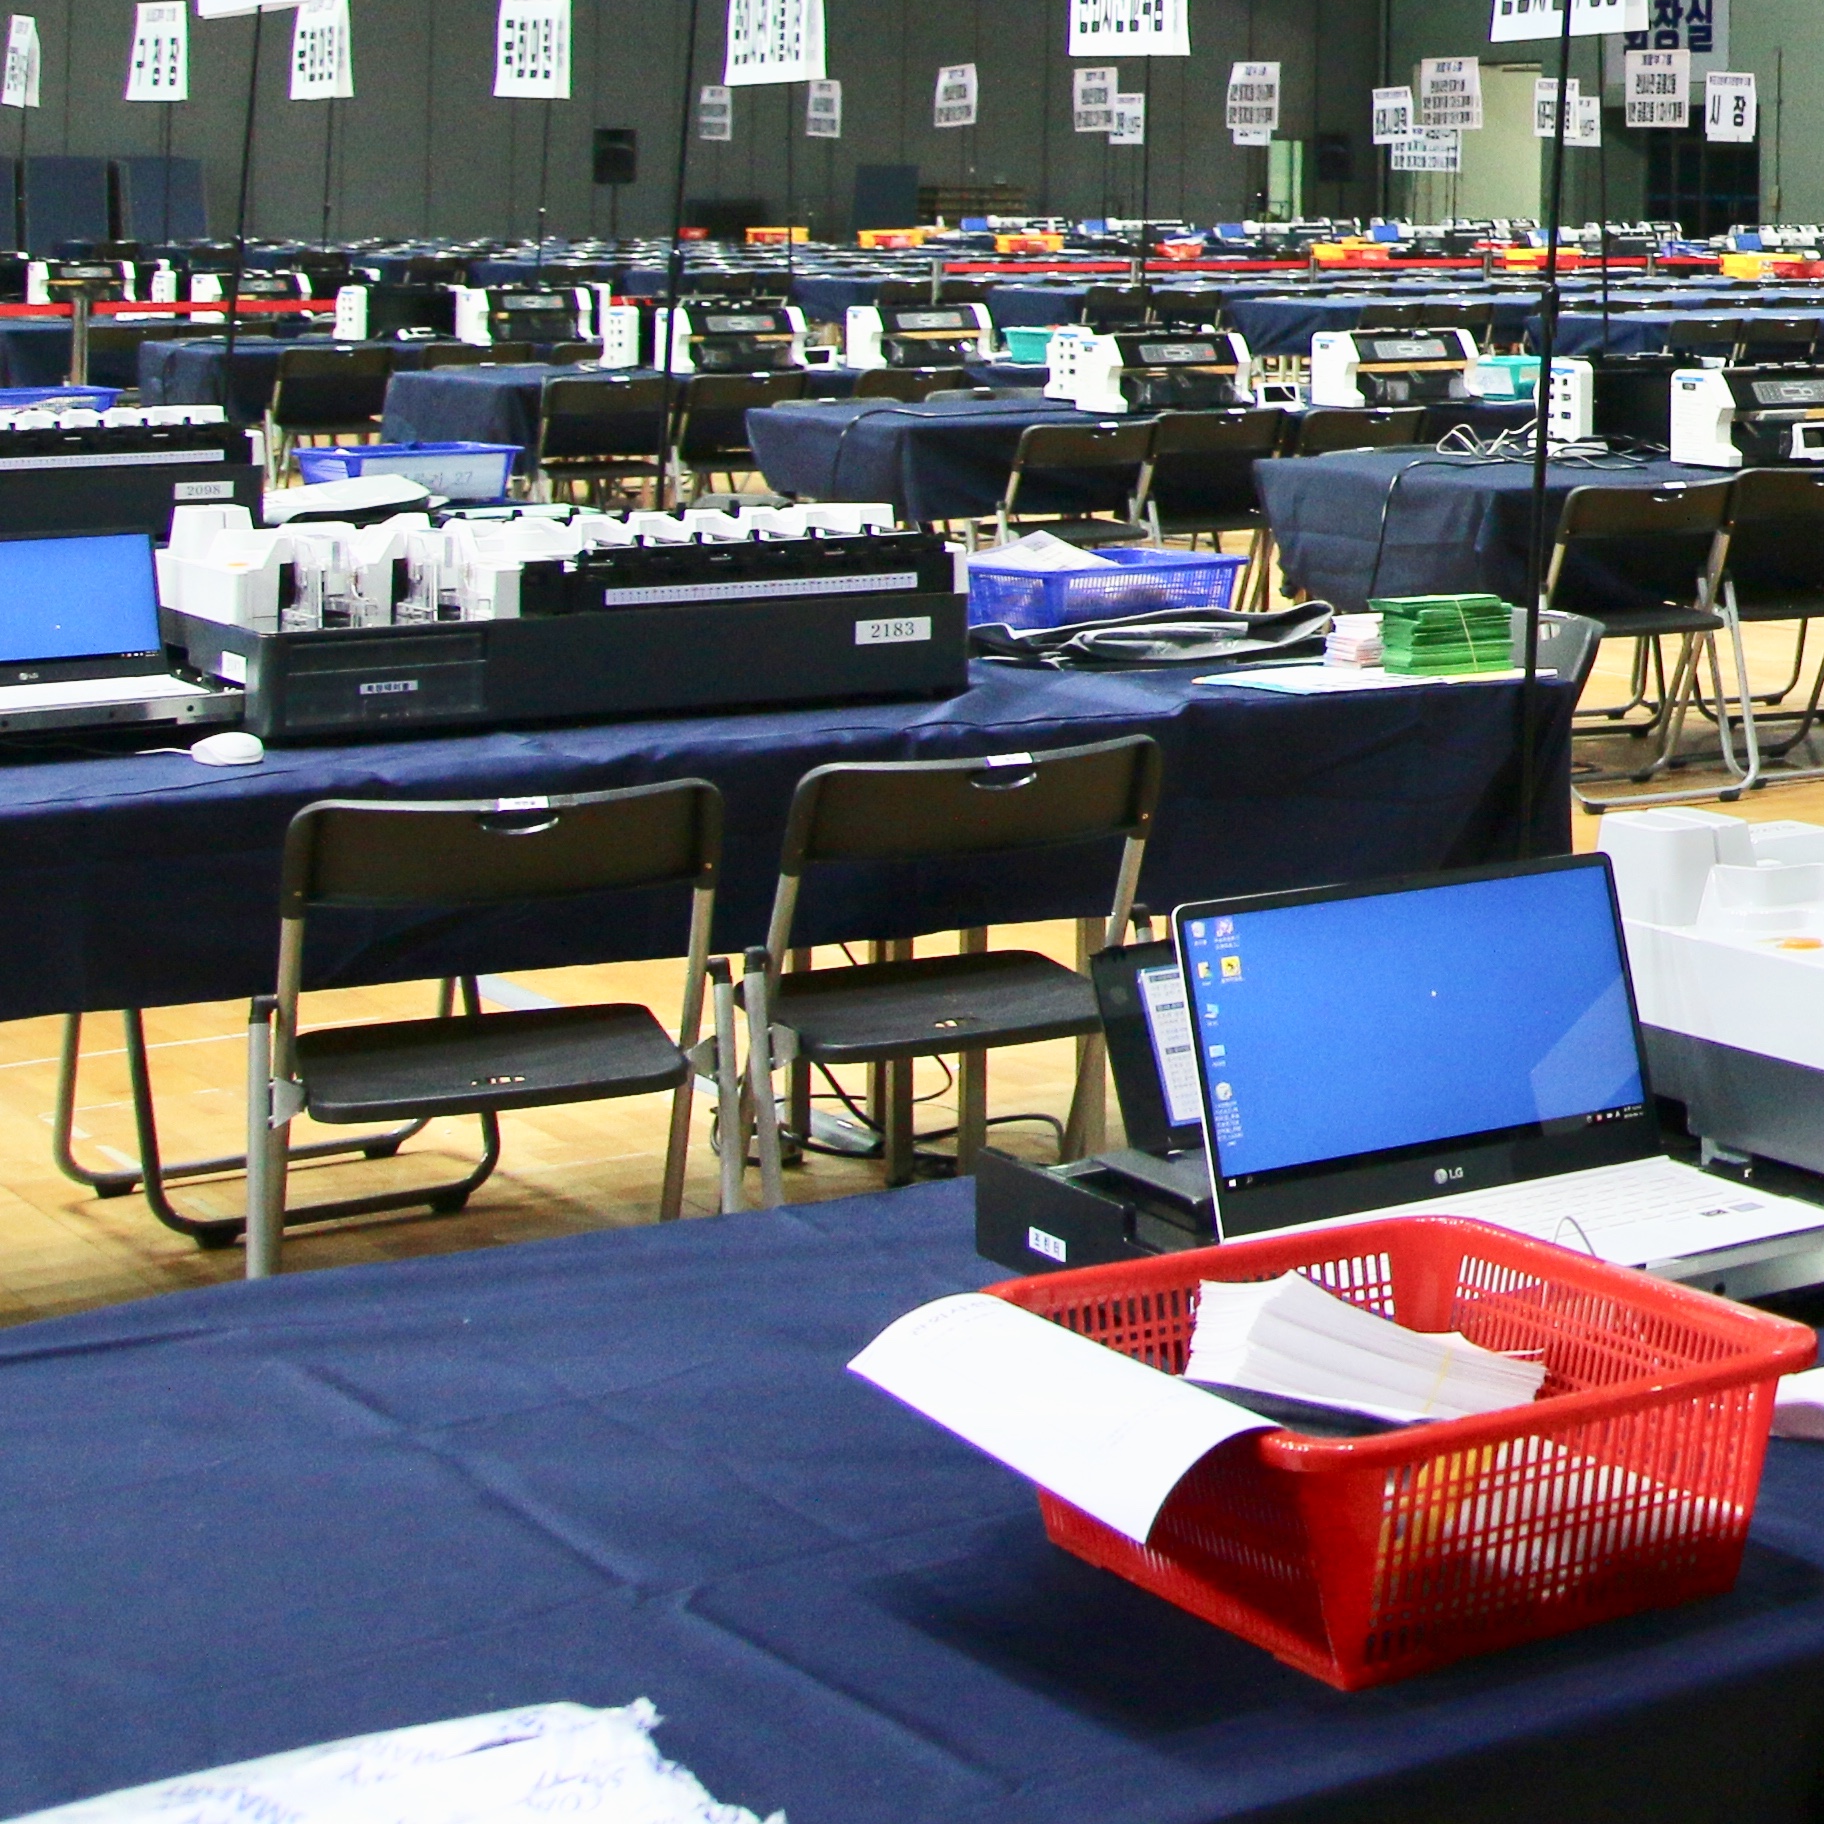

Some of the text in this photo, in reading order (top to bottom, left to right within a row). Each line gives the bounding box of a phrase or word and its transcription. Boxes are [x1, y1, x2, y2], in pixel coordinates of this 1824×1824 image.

[187, 484, 221, 496] 2098
[871, 621, 914, 638] 2183
[1449, 1166, 1464, 1180] LG
